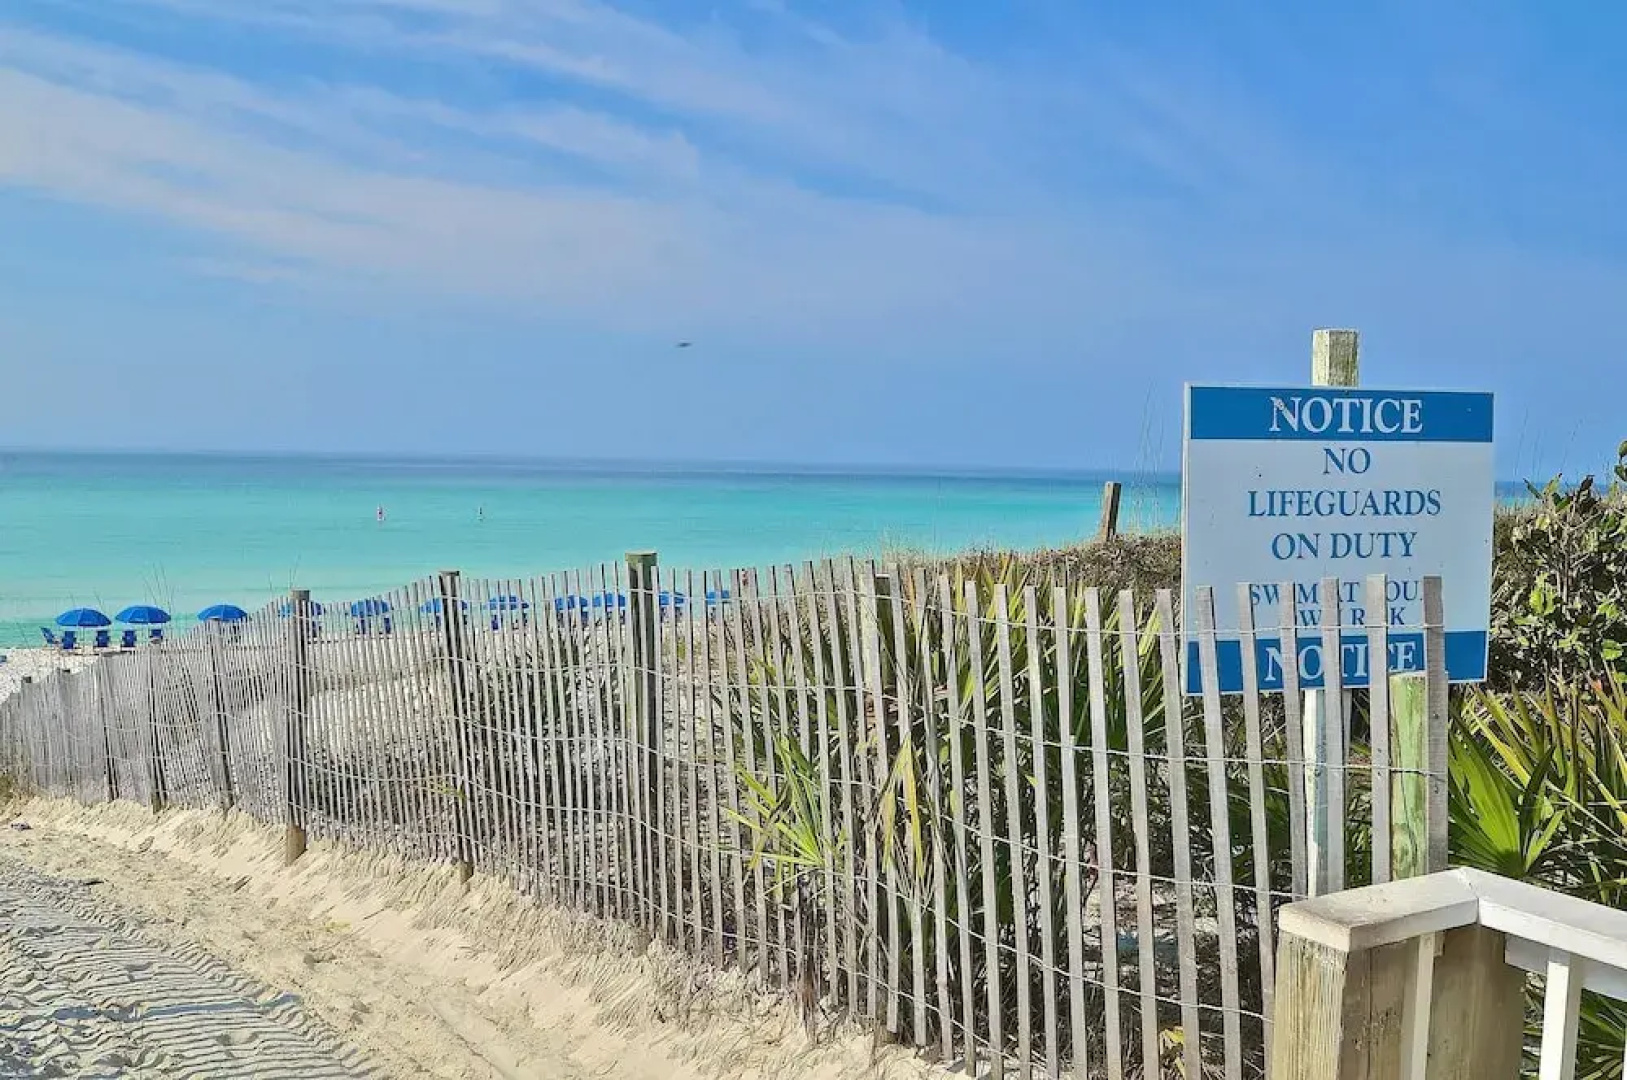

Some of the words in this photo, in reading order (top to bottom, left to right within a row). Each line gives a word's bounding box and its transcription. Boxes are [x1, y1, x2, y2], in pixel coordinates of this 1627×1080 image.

[1269, 396, 1423, 434] NOTICE
[1322, 447, 1371, 474] NO
[1247, 489, 1441, 517] LIFEGUARDS
[1271, 532, 1321, 560] ON
[1330, 531, 1418, 559] DUTY
[1250, 582, 1319, 606] SWM
[1350, 606, 1406, 626] RK
[1263, 641, 1417, 682] NOIE
